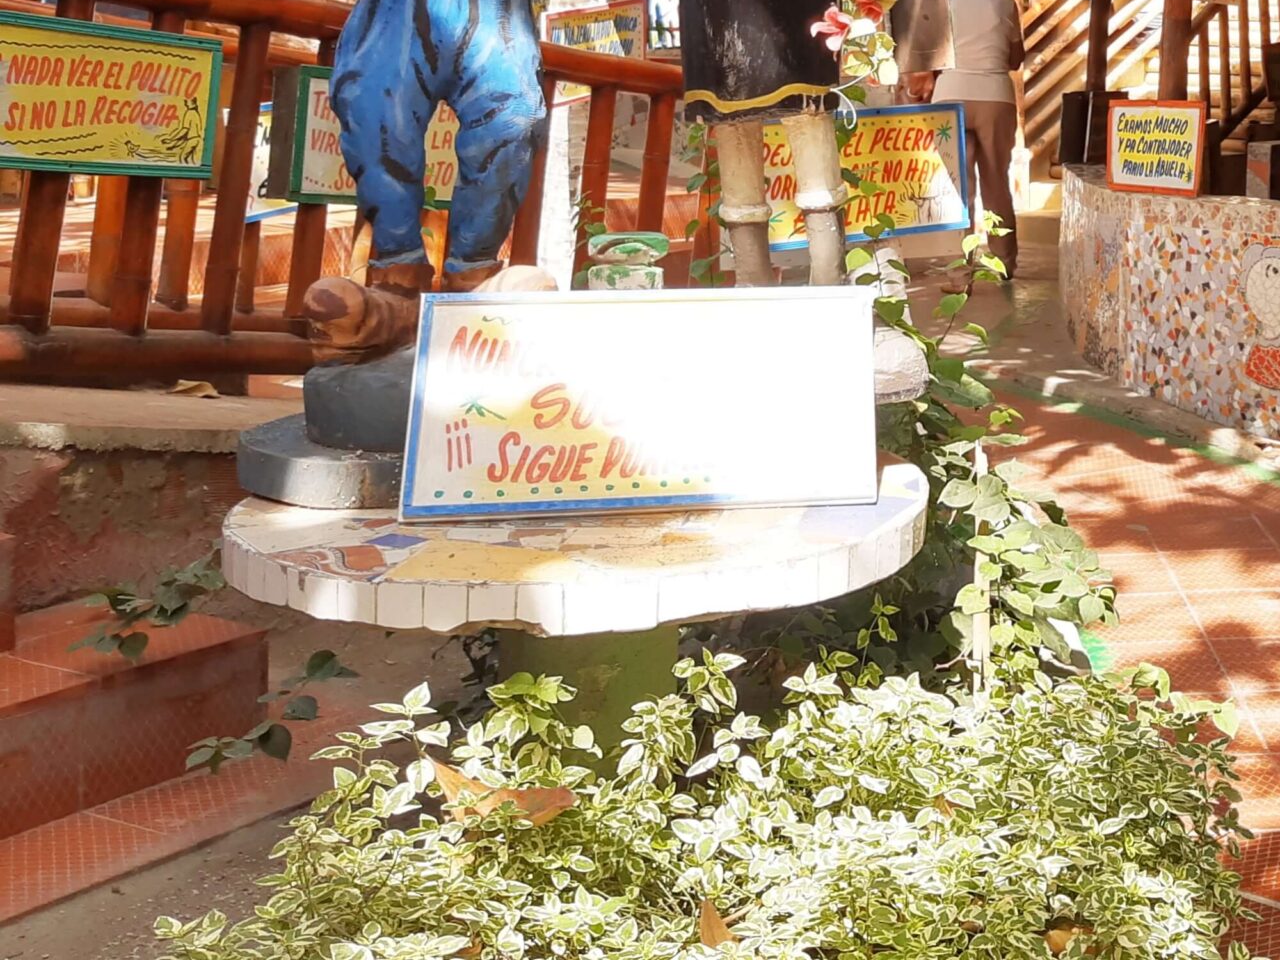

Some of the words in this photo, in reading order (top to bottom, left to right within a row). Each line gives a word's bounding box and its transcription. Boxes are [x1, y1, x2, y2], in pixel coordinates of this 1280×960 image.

[6, 54, 64, 86] NADA
[67, 55, 103, 88] VER
[103, 62, 123, 89] EL
[125, 60, 202, 100] POLLITO
[4, 101, 26, 131] SI
[30, 100, 57, 129] NO
[62, 99, 85, 128] LA
[1117, 112, 1152, 135] ERAMOS
[1152, 115, 1188, 135] MUCHO
[431, 131, 451, 150] LA
[1118, 136, 1124, 153] Y
[1124, 138, 1135, 153] PA
[881, 159, 904, 183] NO
[904, 158, 941, 183] HAY
[1145, 161, 1153, 177] LA
[1154, 157, 1185, 178] ABUELA
[486, 430, 598, 484] SIGUE
